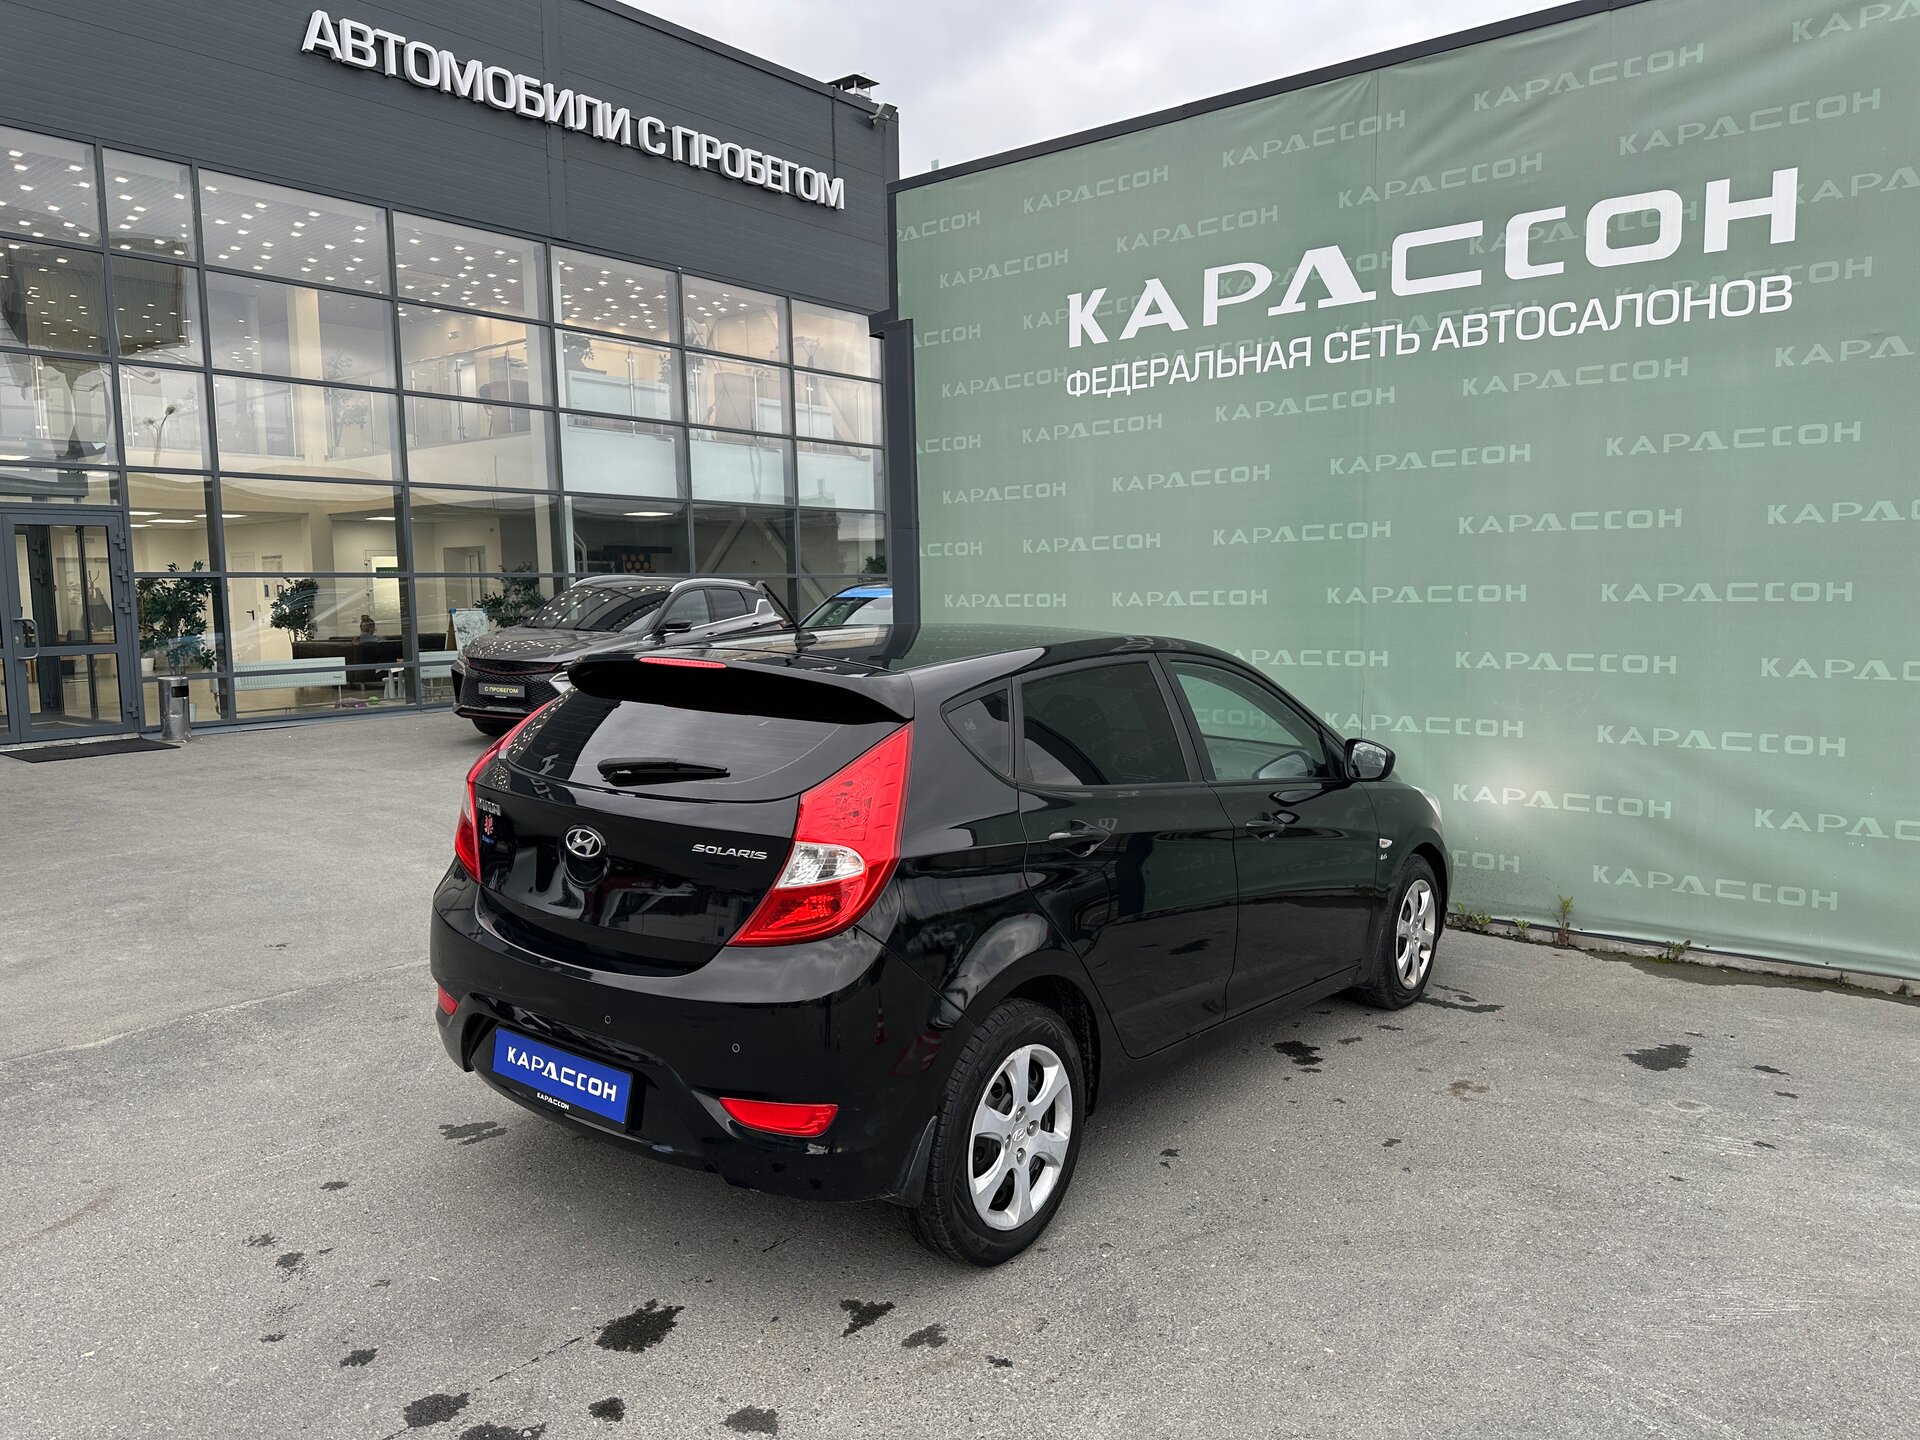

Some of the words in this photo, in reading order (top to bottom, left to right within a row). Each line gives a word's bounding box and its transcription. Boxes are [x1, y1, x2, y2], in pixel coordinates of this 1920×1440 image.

[302, 9, 631, 146] АВТОМОБИЛИ
[638, 116, 666, 156] С
[672, 125, 845, 210] ПРОБЕГОМ
[1066, 335, 1312, 398] ФЕДЕРАЛЬНАЯ
[1324, 323, 1421, 365] СЕТЬ
[1431, 275, 1793, 352] АВТОСАЛОНОВ
[691, 843, 768, 861] SOLARIS
